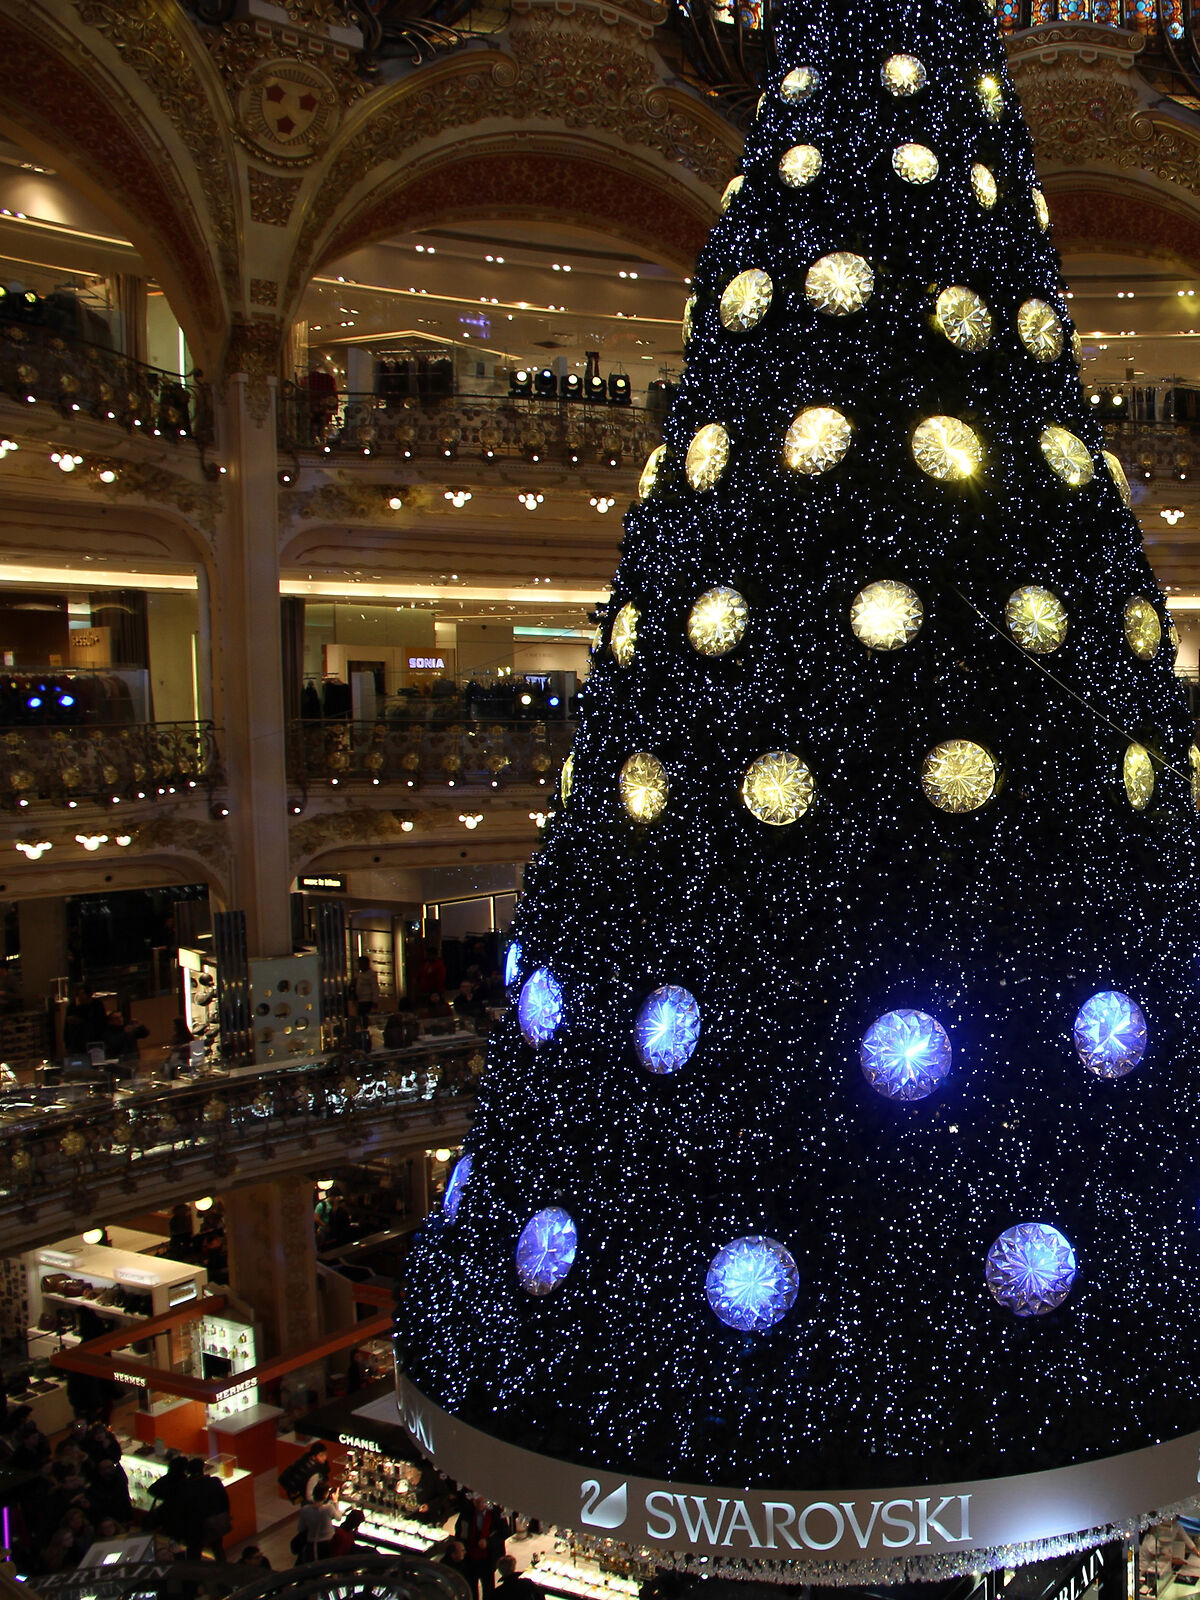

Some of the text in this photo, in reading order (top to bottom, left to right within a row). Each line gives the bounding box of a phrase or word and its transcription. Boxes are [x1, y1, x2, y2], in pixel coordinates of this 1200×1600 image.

[408, 657, 445, 669] SONIA
[338, 1433, 382, 1454] CHANEL
[645, 1490, 973, 1551] SWAROVSKI
